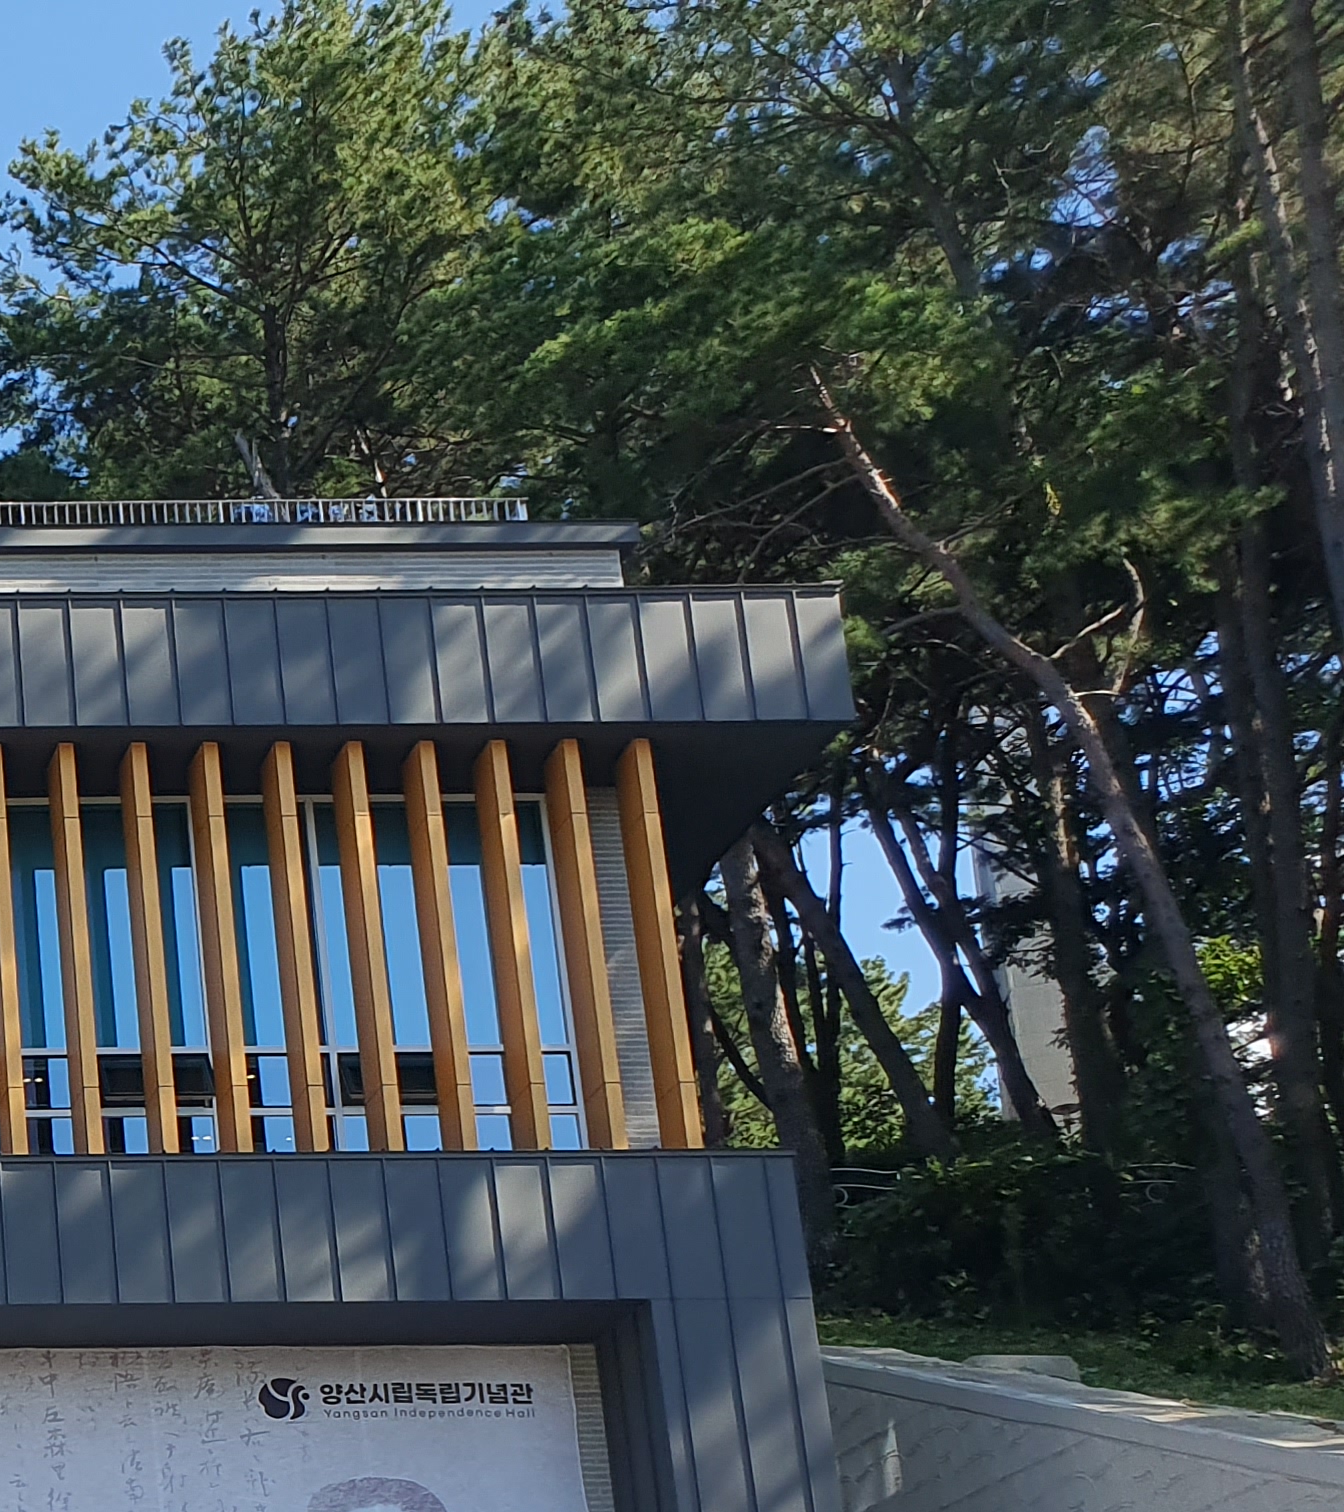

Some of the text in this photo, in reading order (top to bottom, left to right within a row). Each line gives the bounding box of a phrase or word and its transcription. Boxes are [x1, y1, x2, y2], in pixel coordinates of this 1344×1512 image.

[319, 1382, 534, 1406] 양산시립독립기념관
[323, 1408, 536, 1420] Yangsan Independence Hall
